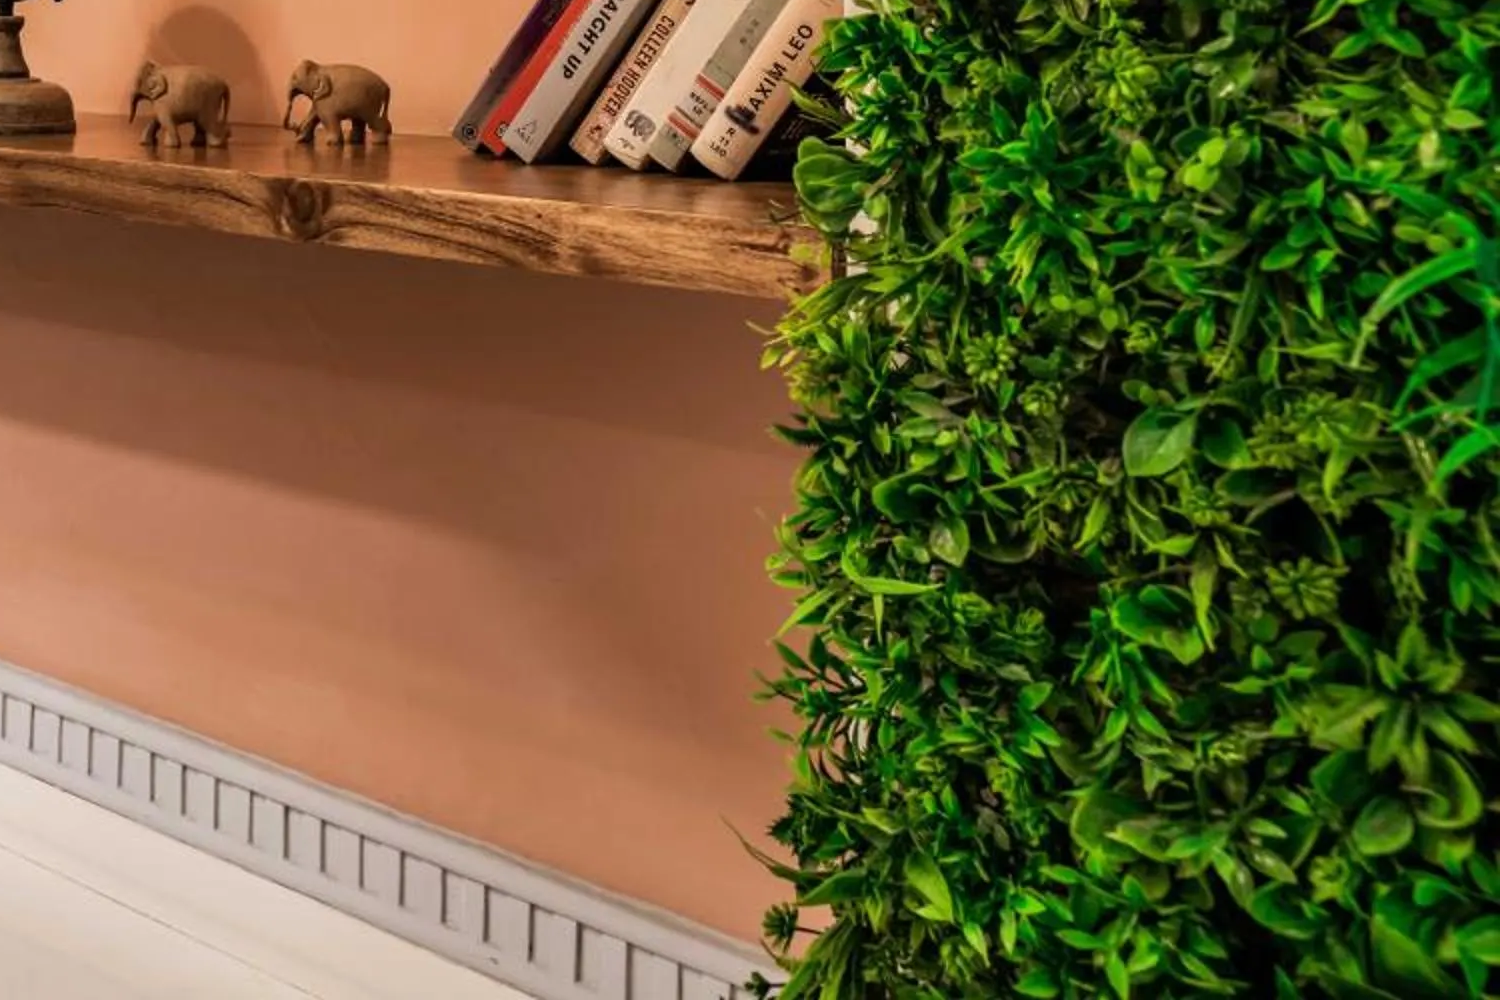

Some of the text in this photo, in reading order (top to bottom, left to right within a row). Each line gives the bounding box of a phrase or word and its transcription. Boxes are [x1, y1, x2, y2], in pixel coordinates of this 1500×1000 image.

[634, 15, 675, 69] COLLEEN
[782, 24, 814, 61] LEO
[563, 55, 581, 79] UP
[601, 66, 641, 117] HOOVER
